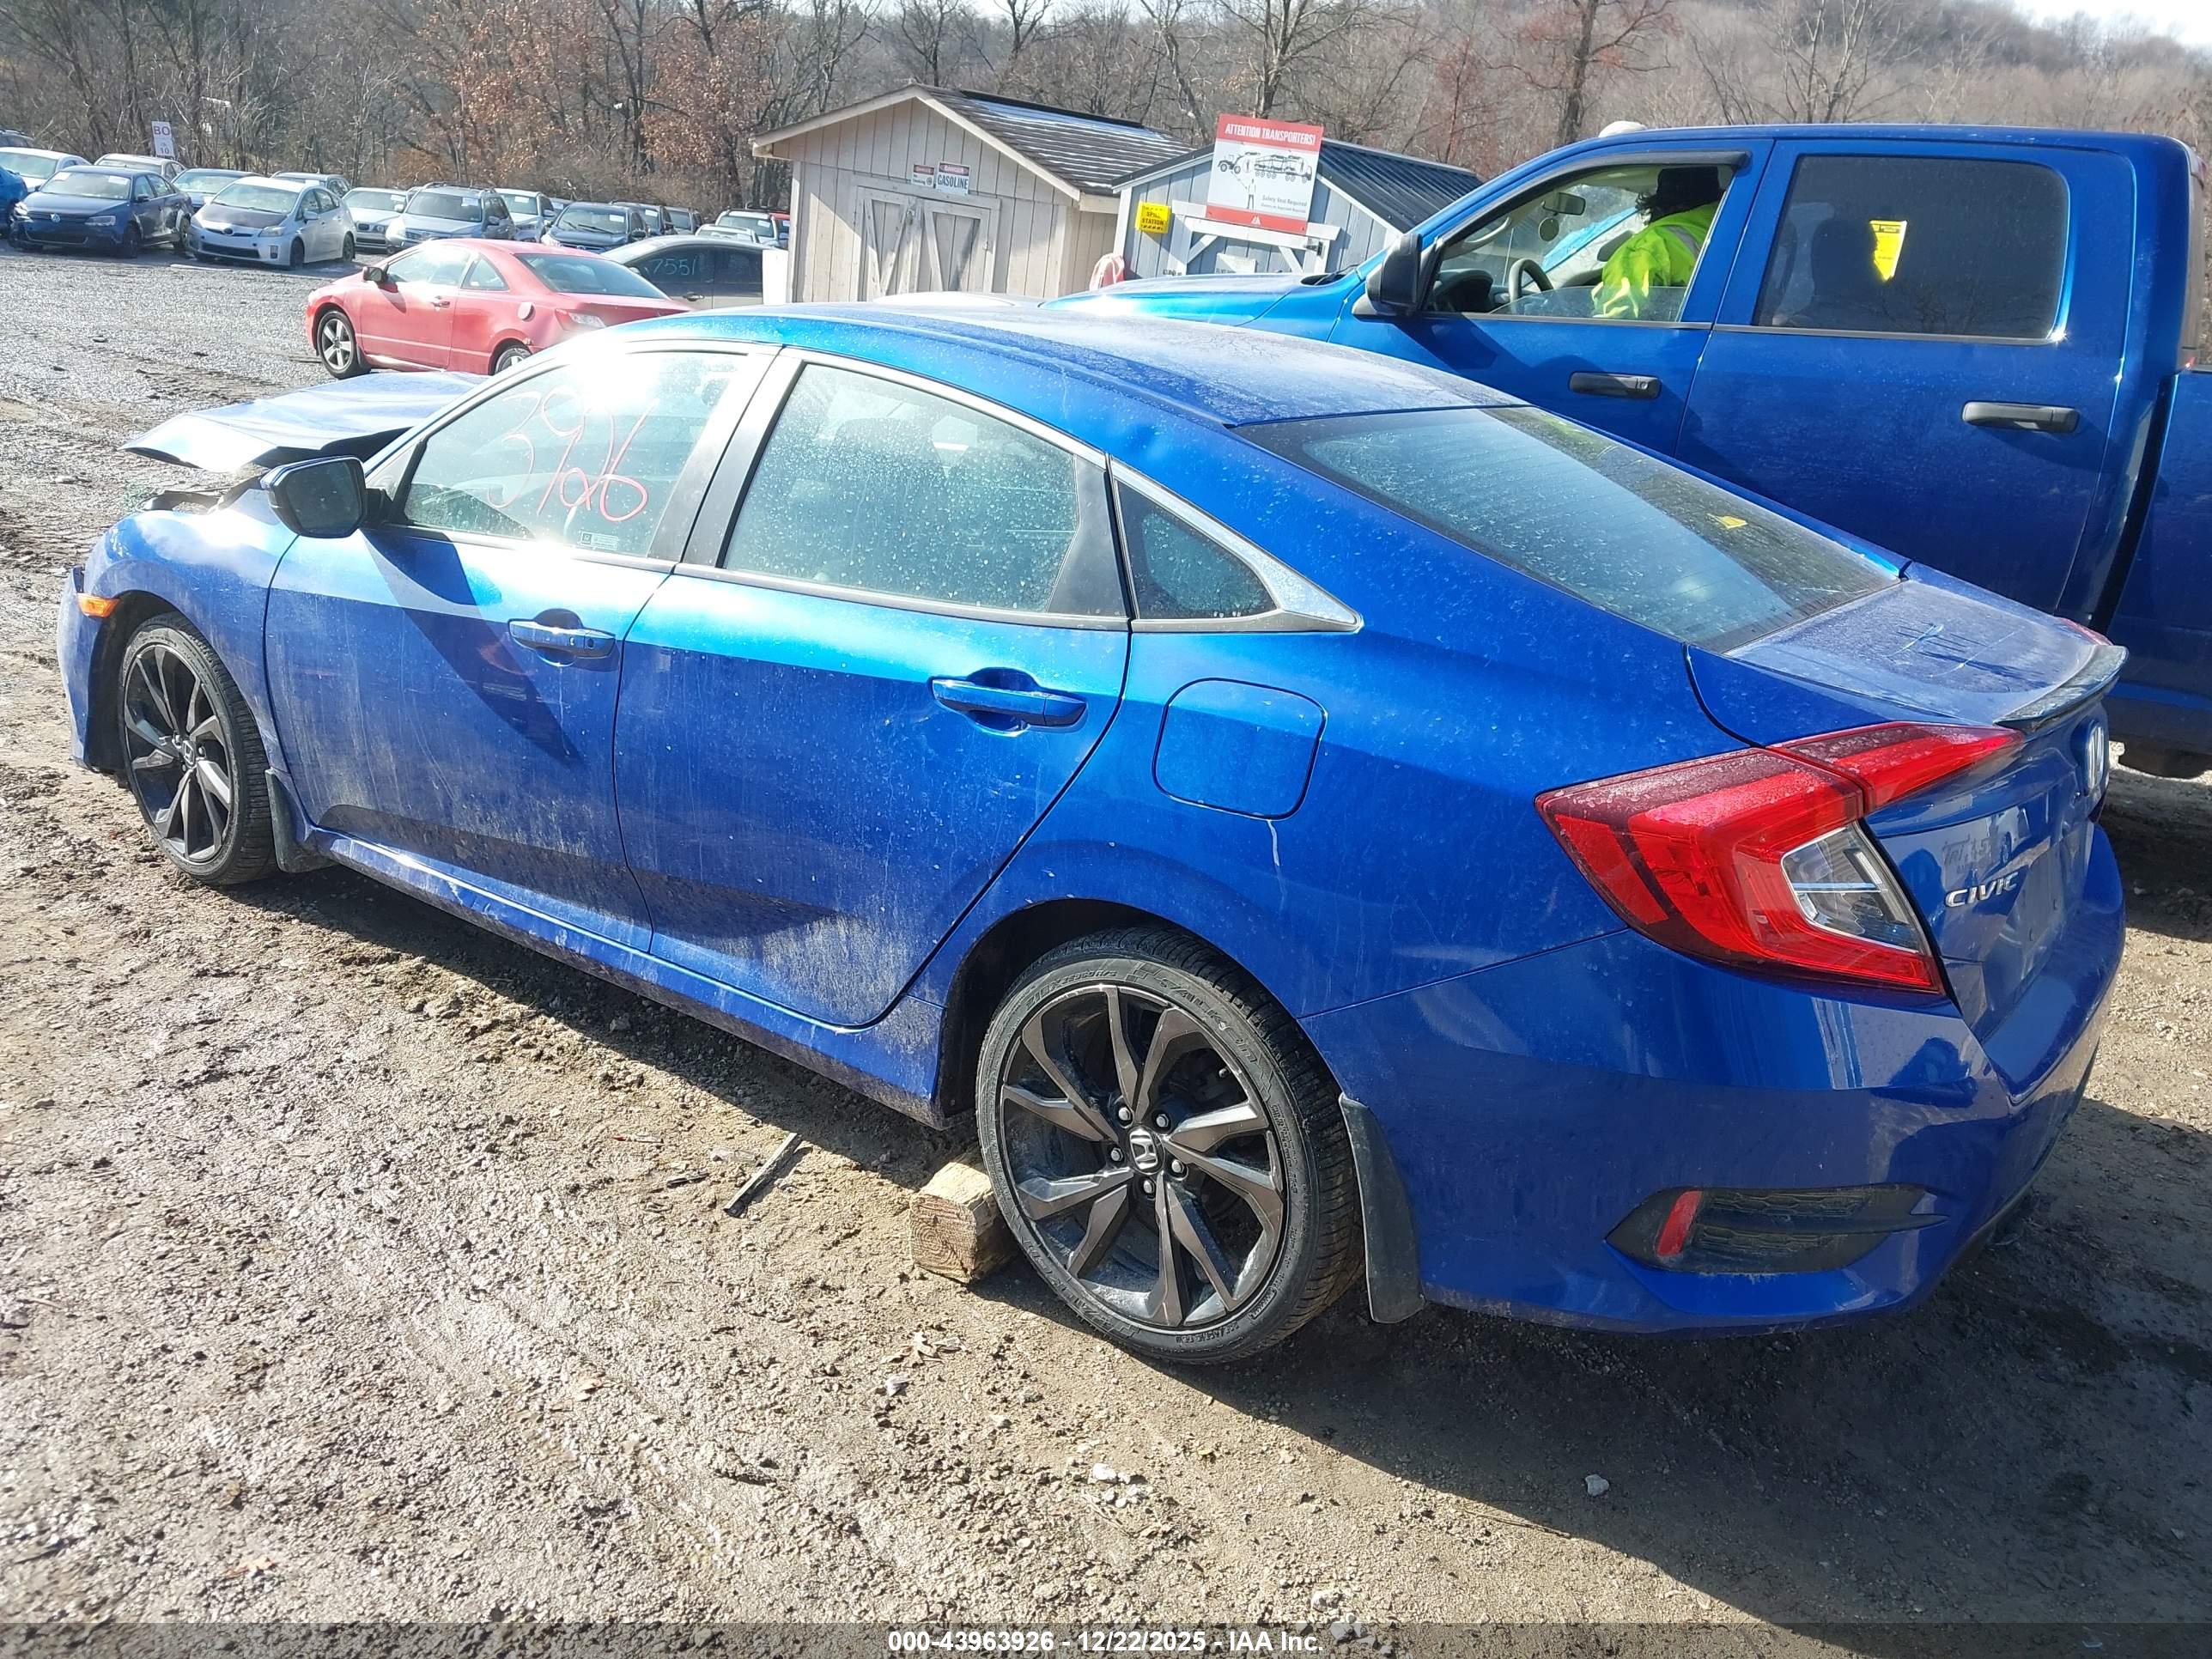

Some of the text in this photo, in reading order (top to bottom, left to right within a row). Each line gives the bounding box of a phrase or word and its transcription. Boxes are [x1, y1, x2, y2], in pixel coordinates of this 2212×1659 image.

[154, 126, 170, 136] BO
[1224, 123, 1316, 145] ATTENTION TRANSPORTERS!
[938, 174, 969, 189] GASOLINE
[1141, 217, 1164, 226] STATION
[649, 258, 696, 276] 7551
[1944, 872, 2019, 908] CIVIC
